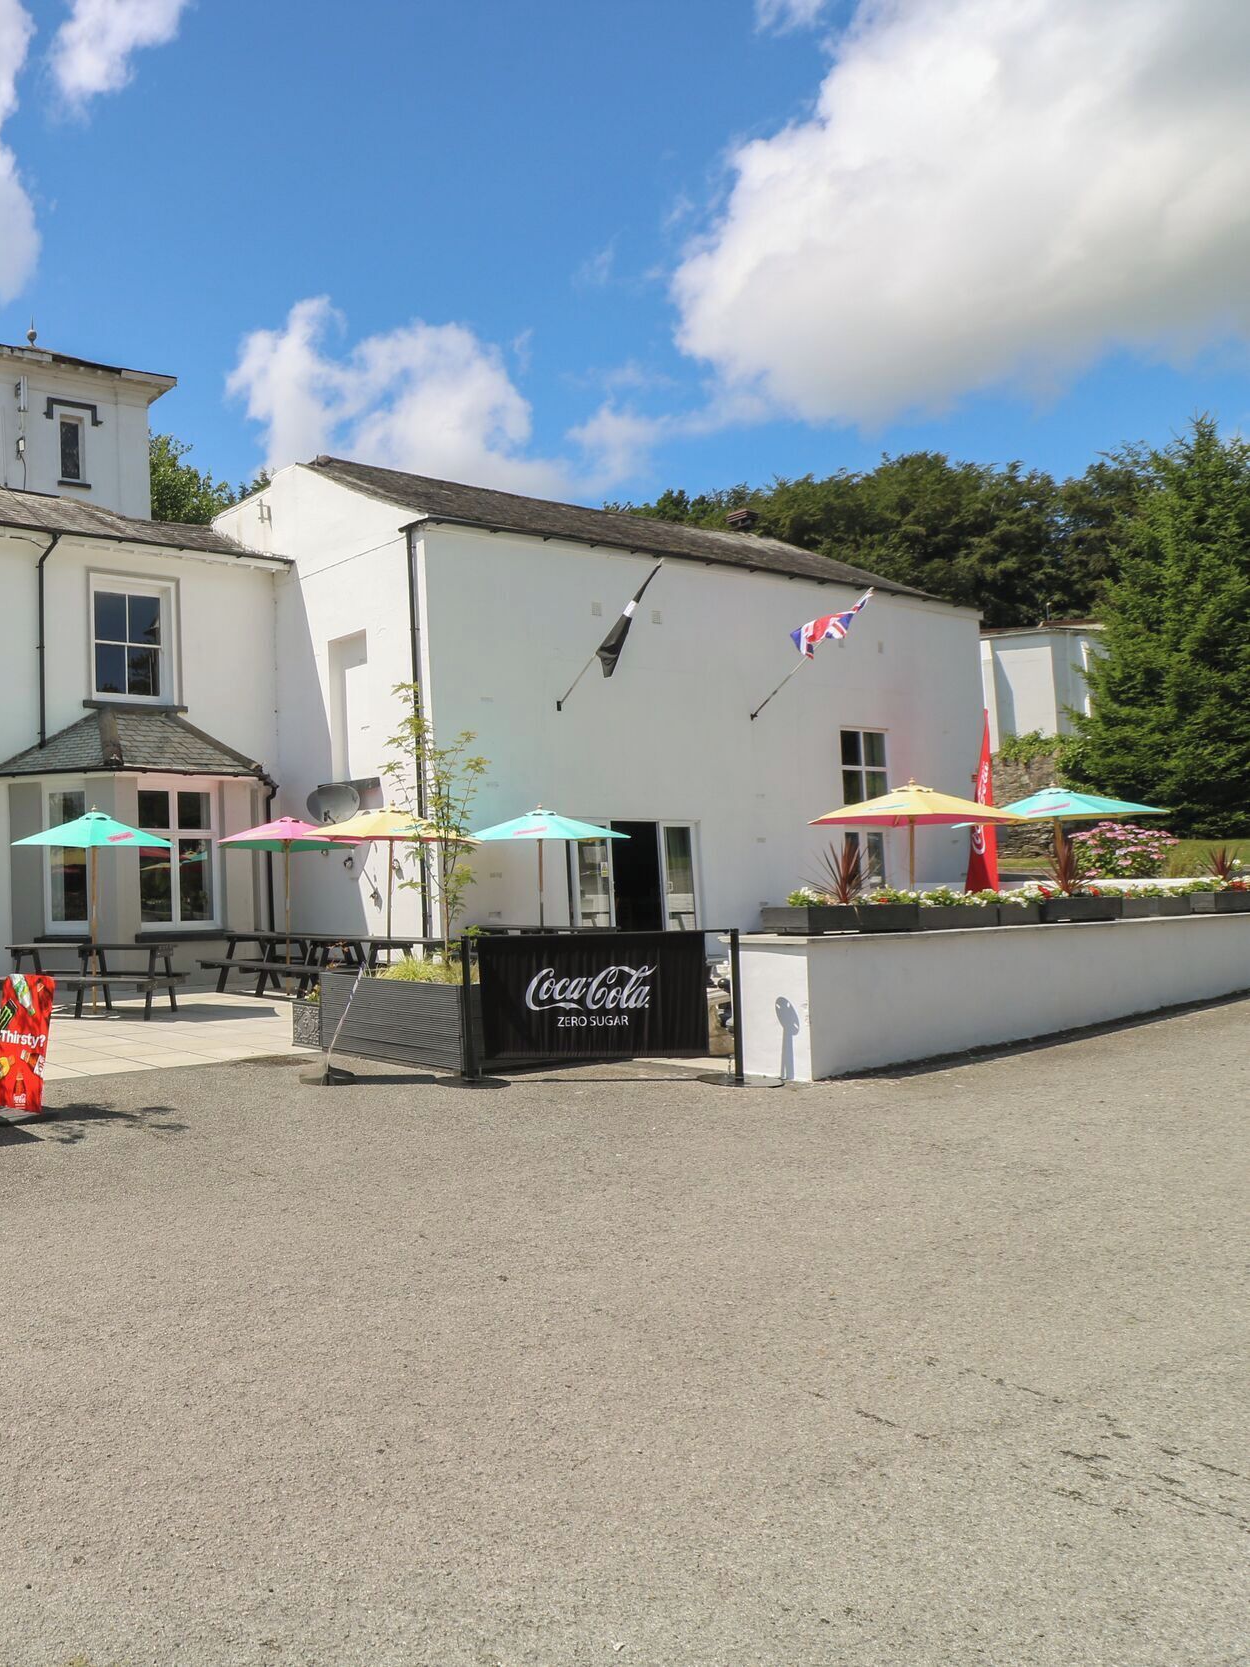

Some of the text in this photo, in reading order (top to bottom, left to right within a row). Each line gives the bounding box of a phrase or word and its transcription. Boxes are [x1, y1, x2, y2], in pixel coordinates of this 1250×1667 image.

[525, 964, 657, 1011] Coca-Cola
[557, 1015, 629, 1027] ZERO SUGAR
[0, 1030, 46, 1049] Thirsty?
